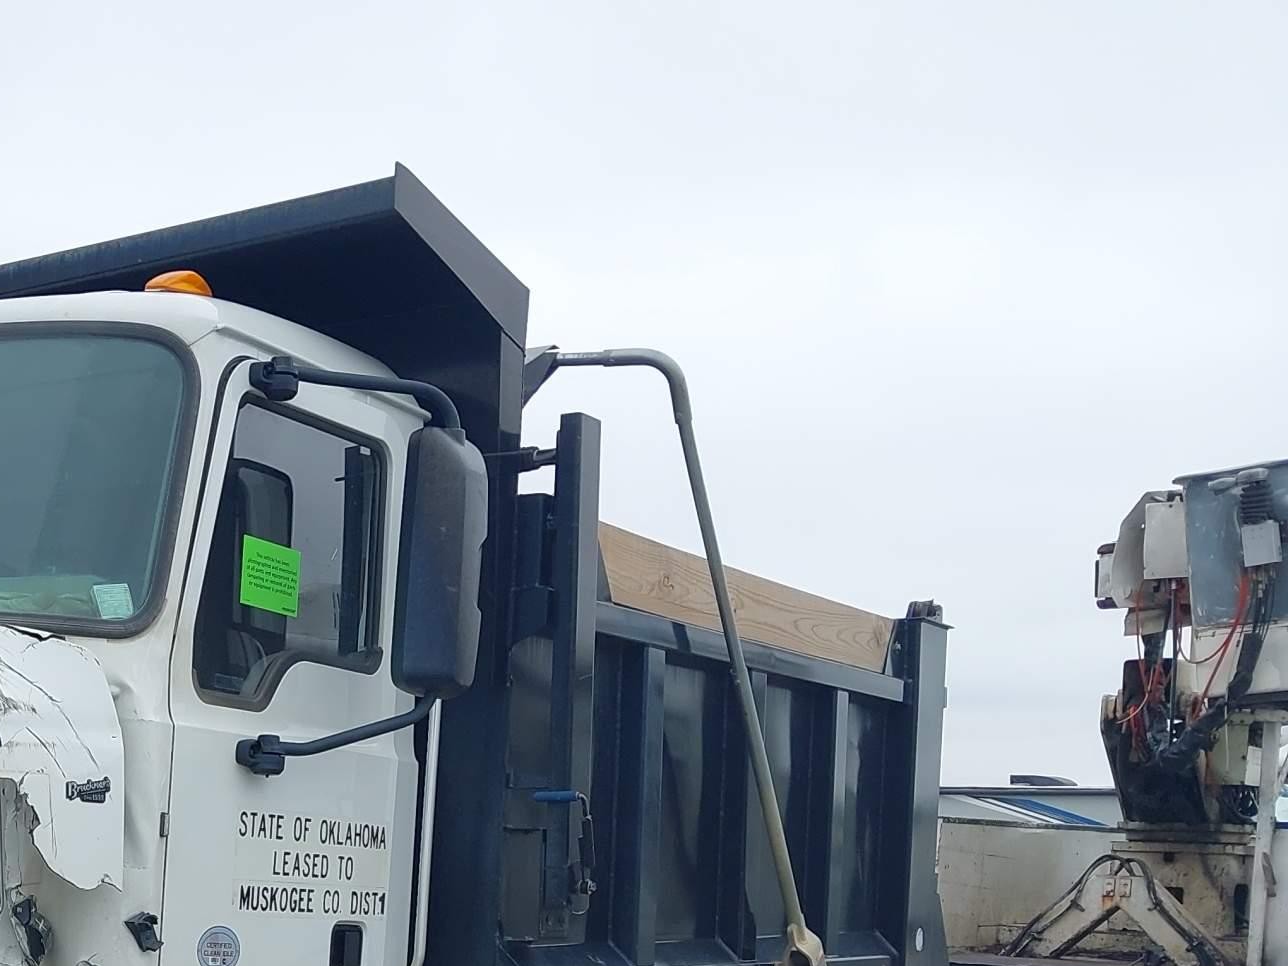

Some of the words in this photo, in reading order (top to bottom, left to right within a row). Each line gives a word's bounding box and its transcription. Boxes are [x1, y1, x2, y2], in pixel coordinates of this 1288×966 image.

[239, 811, 284, 840] STATE
[293, 817, 312, 842] OF
[319, 819, 386, 850] OKLAHOMA
[272, 851, 329, 878] LEASED
[338, 856, 354, 880] TO
[239, 885, 315, 913] MUSKOGEE
[323, 890, 342, 914] CO.
